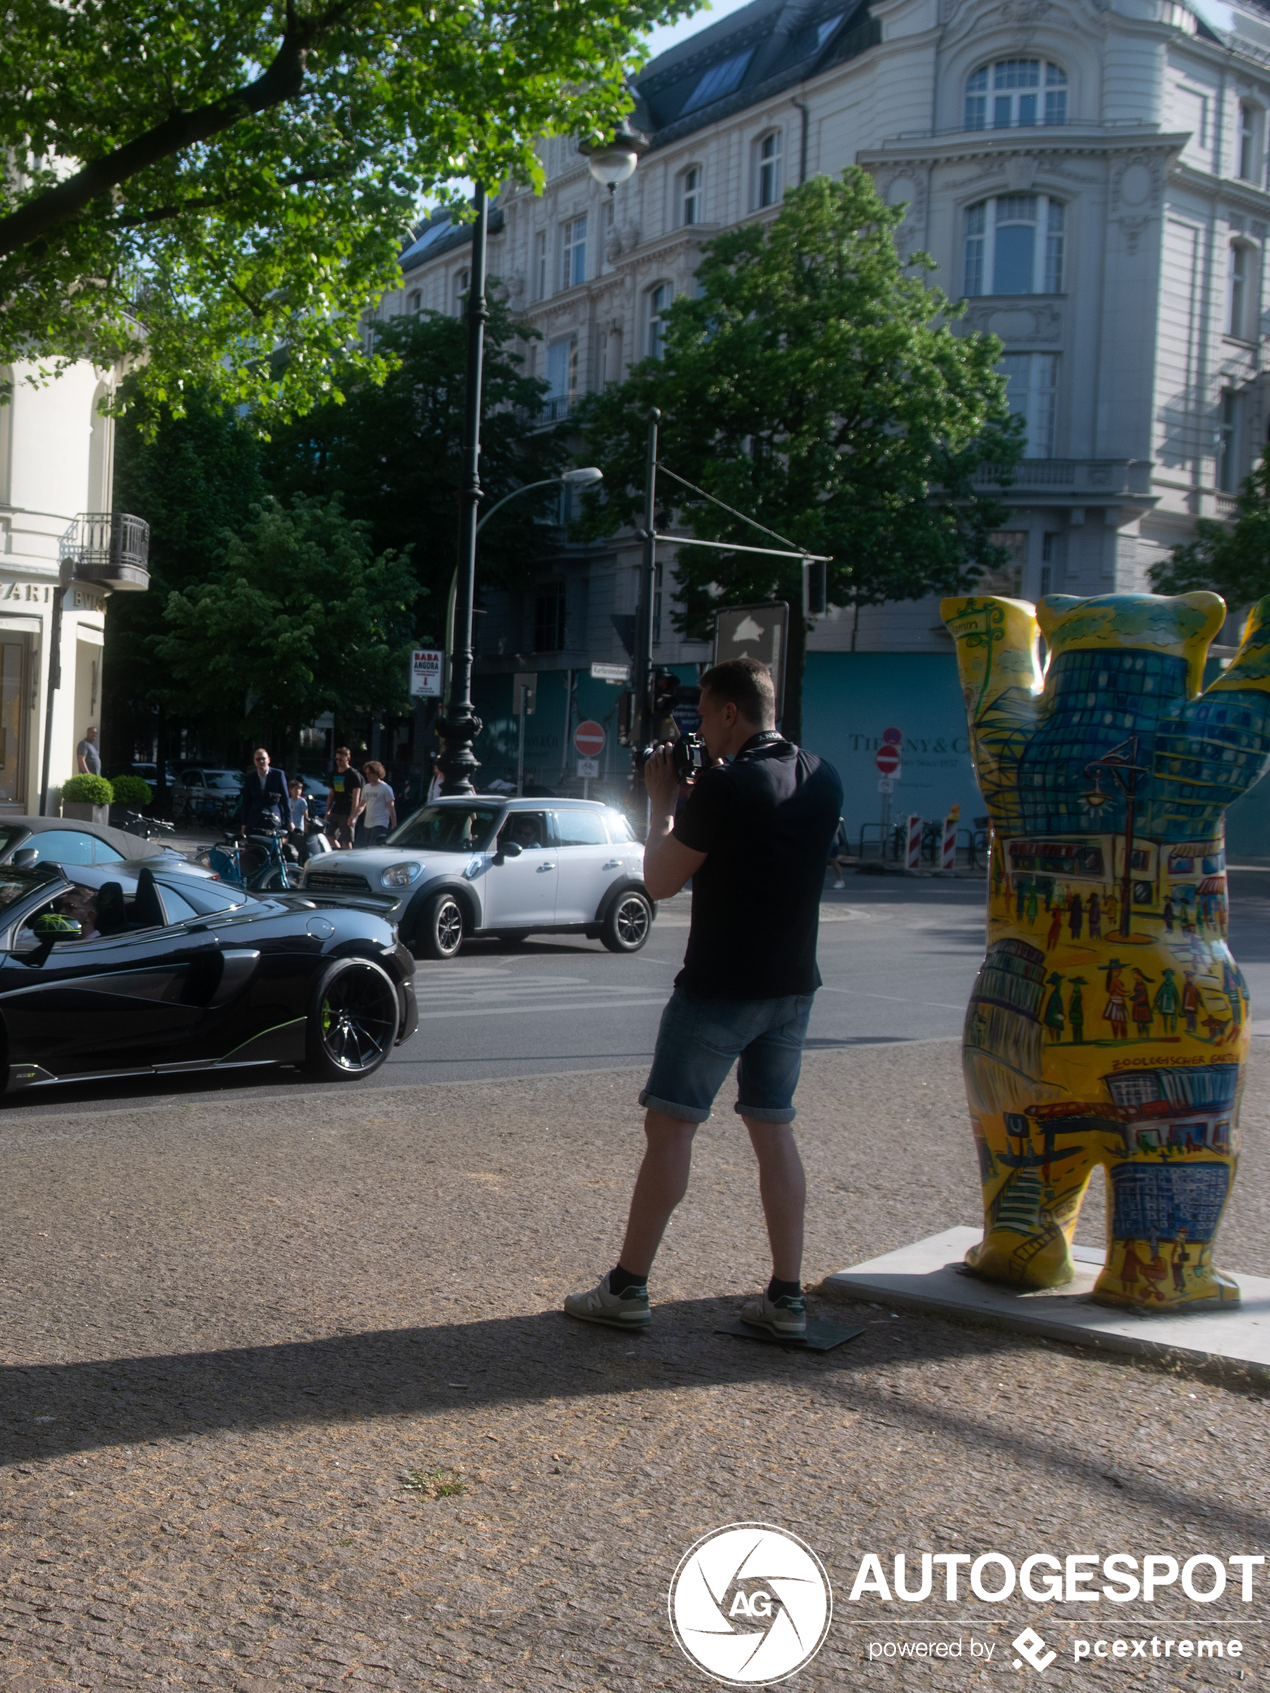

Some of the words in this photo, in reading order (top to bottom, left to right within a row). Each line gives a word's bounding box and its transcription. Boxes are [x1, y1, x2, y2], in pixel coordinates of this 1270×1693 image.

[414, 653, 439, 661] BABA
[414, 661, 439, 670] ANGORA
[1112, 1055, 1205, 1070] ZOOLOGISCHER
[1010, 1118, 1023, 1133] U
[587, 1293, 603, 1311] N
